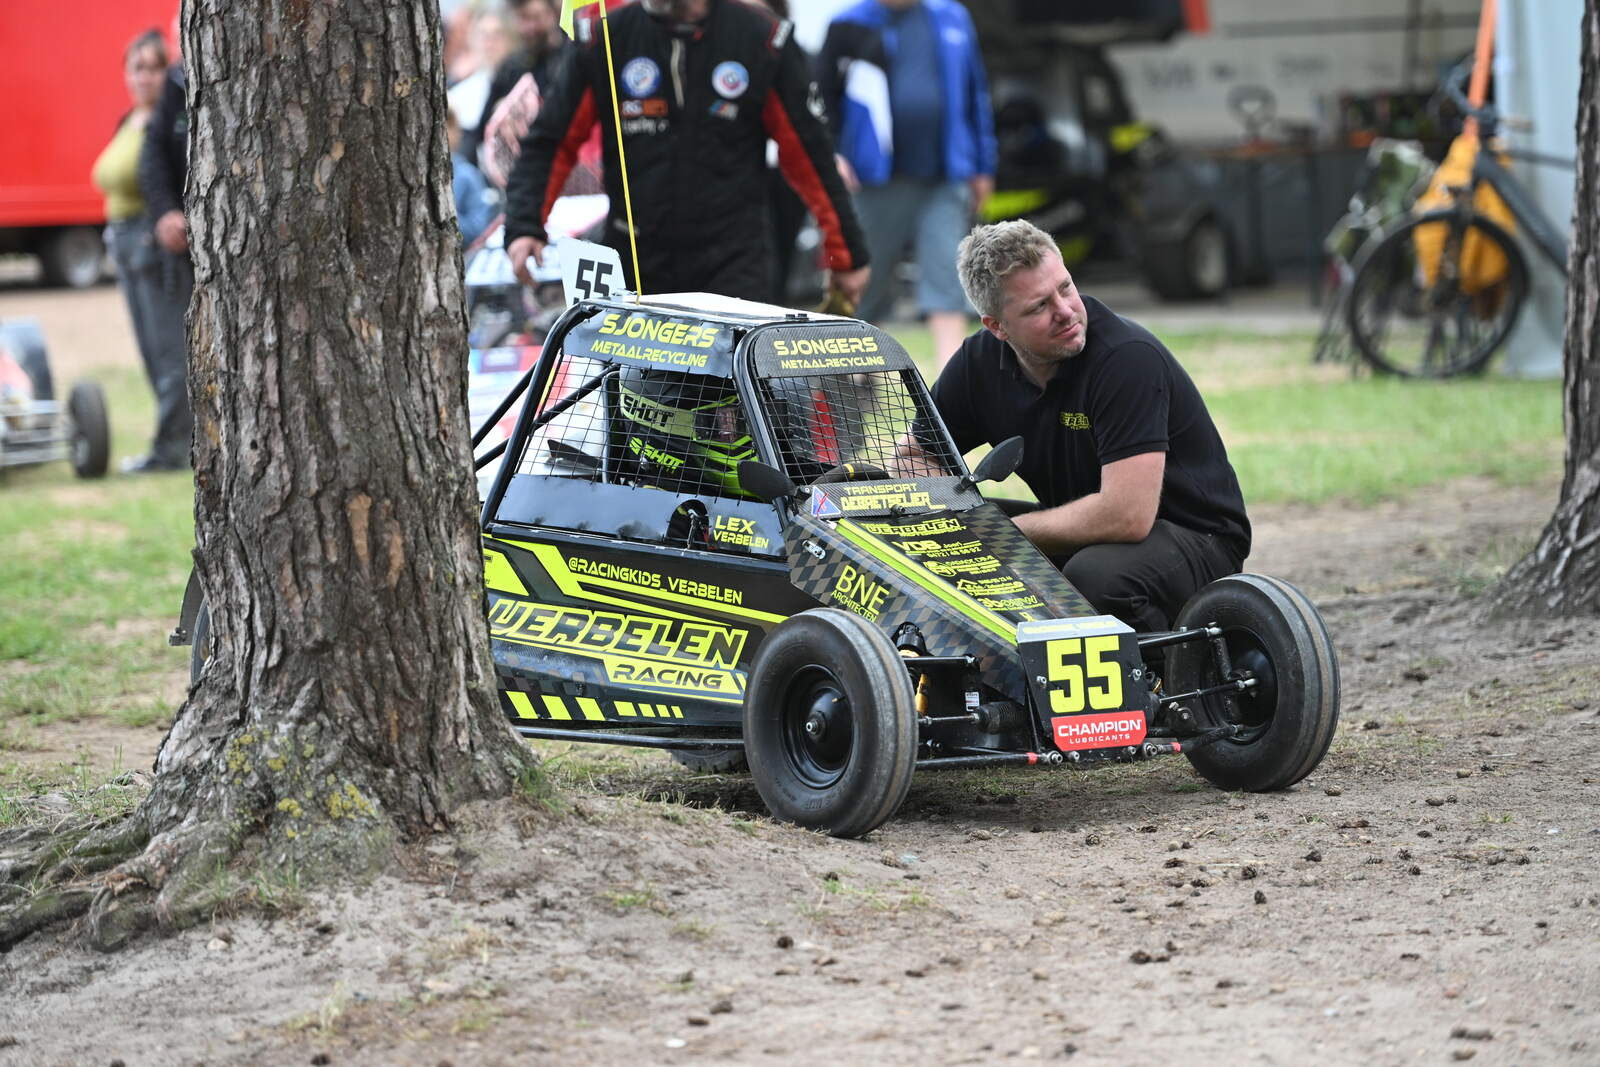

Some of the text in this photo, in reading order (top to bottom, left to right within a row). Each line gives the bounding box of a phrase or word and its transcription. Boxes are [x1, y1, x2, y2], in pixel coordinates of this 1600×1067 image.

[573, 258, 614, 301] 55
[599, 313, 719, 349] SJONGERS
[590, 340, 707, 368] METAALRECYCLING
[774, 336, 878, 356] SJONGERS
[781, 355, 885, 370] METAALRECYCLING
[844, 483, 918, 496] TRANSPORT
[715, 515, 757, 535] LEX
[713, 529, 769, 549] VERBELEN
[892, 540, 942, 551] VDB
[568, 556, 743, 605] @RACINGKIDS_VERBELEN
[835, 564, 890, 616] BNE
[830, 589, 877, 623] ARCHITECTEN
[612, 664, 726, 689] RACING
[1047, 635, 1123, 713] 55
[1058, 720, 1142, 737] CHAMPION
[1069, 734, 1131, 745] LUBRICANTS
